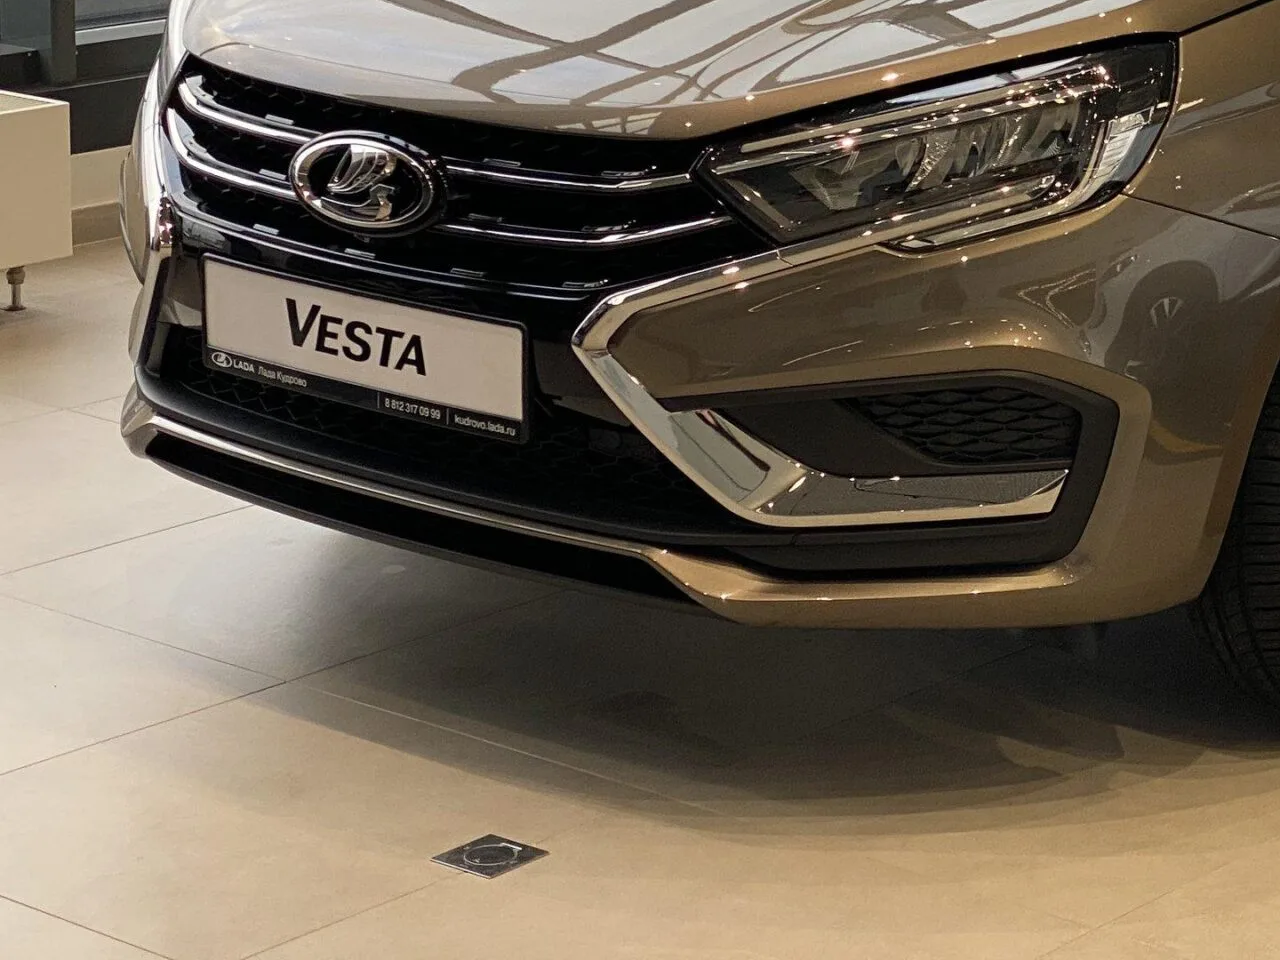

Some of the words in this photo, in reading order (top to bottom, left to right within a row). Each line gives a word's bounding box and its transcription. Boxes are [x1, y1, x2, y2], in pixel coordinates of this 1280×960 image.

[286, 297, 427, 376] VESTA
[233, 359, 255, 373] LADA
[391, 399, 404, 412] 812
[404, 402, 418, 414] 317
[419, 406, 429, 417] 09
[430, 408, 441, 420] 99
[454, 413, 516, 436] kudrovo.lada.ru
